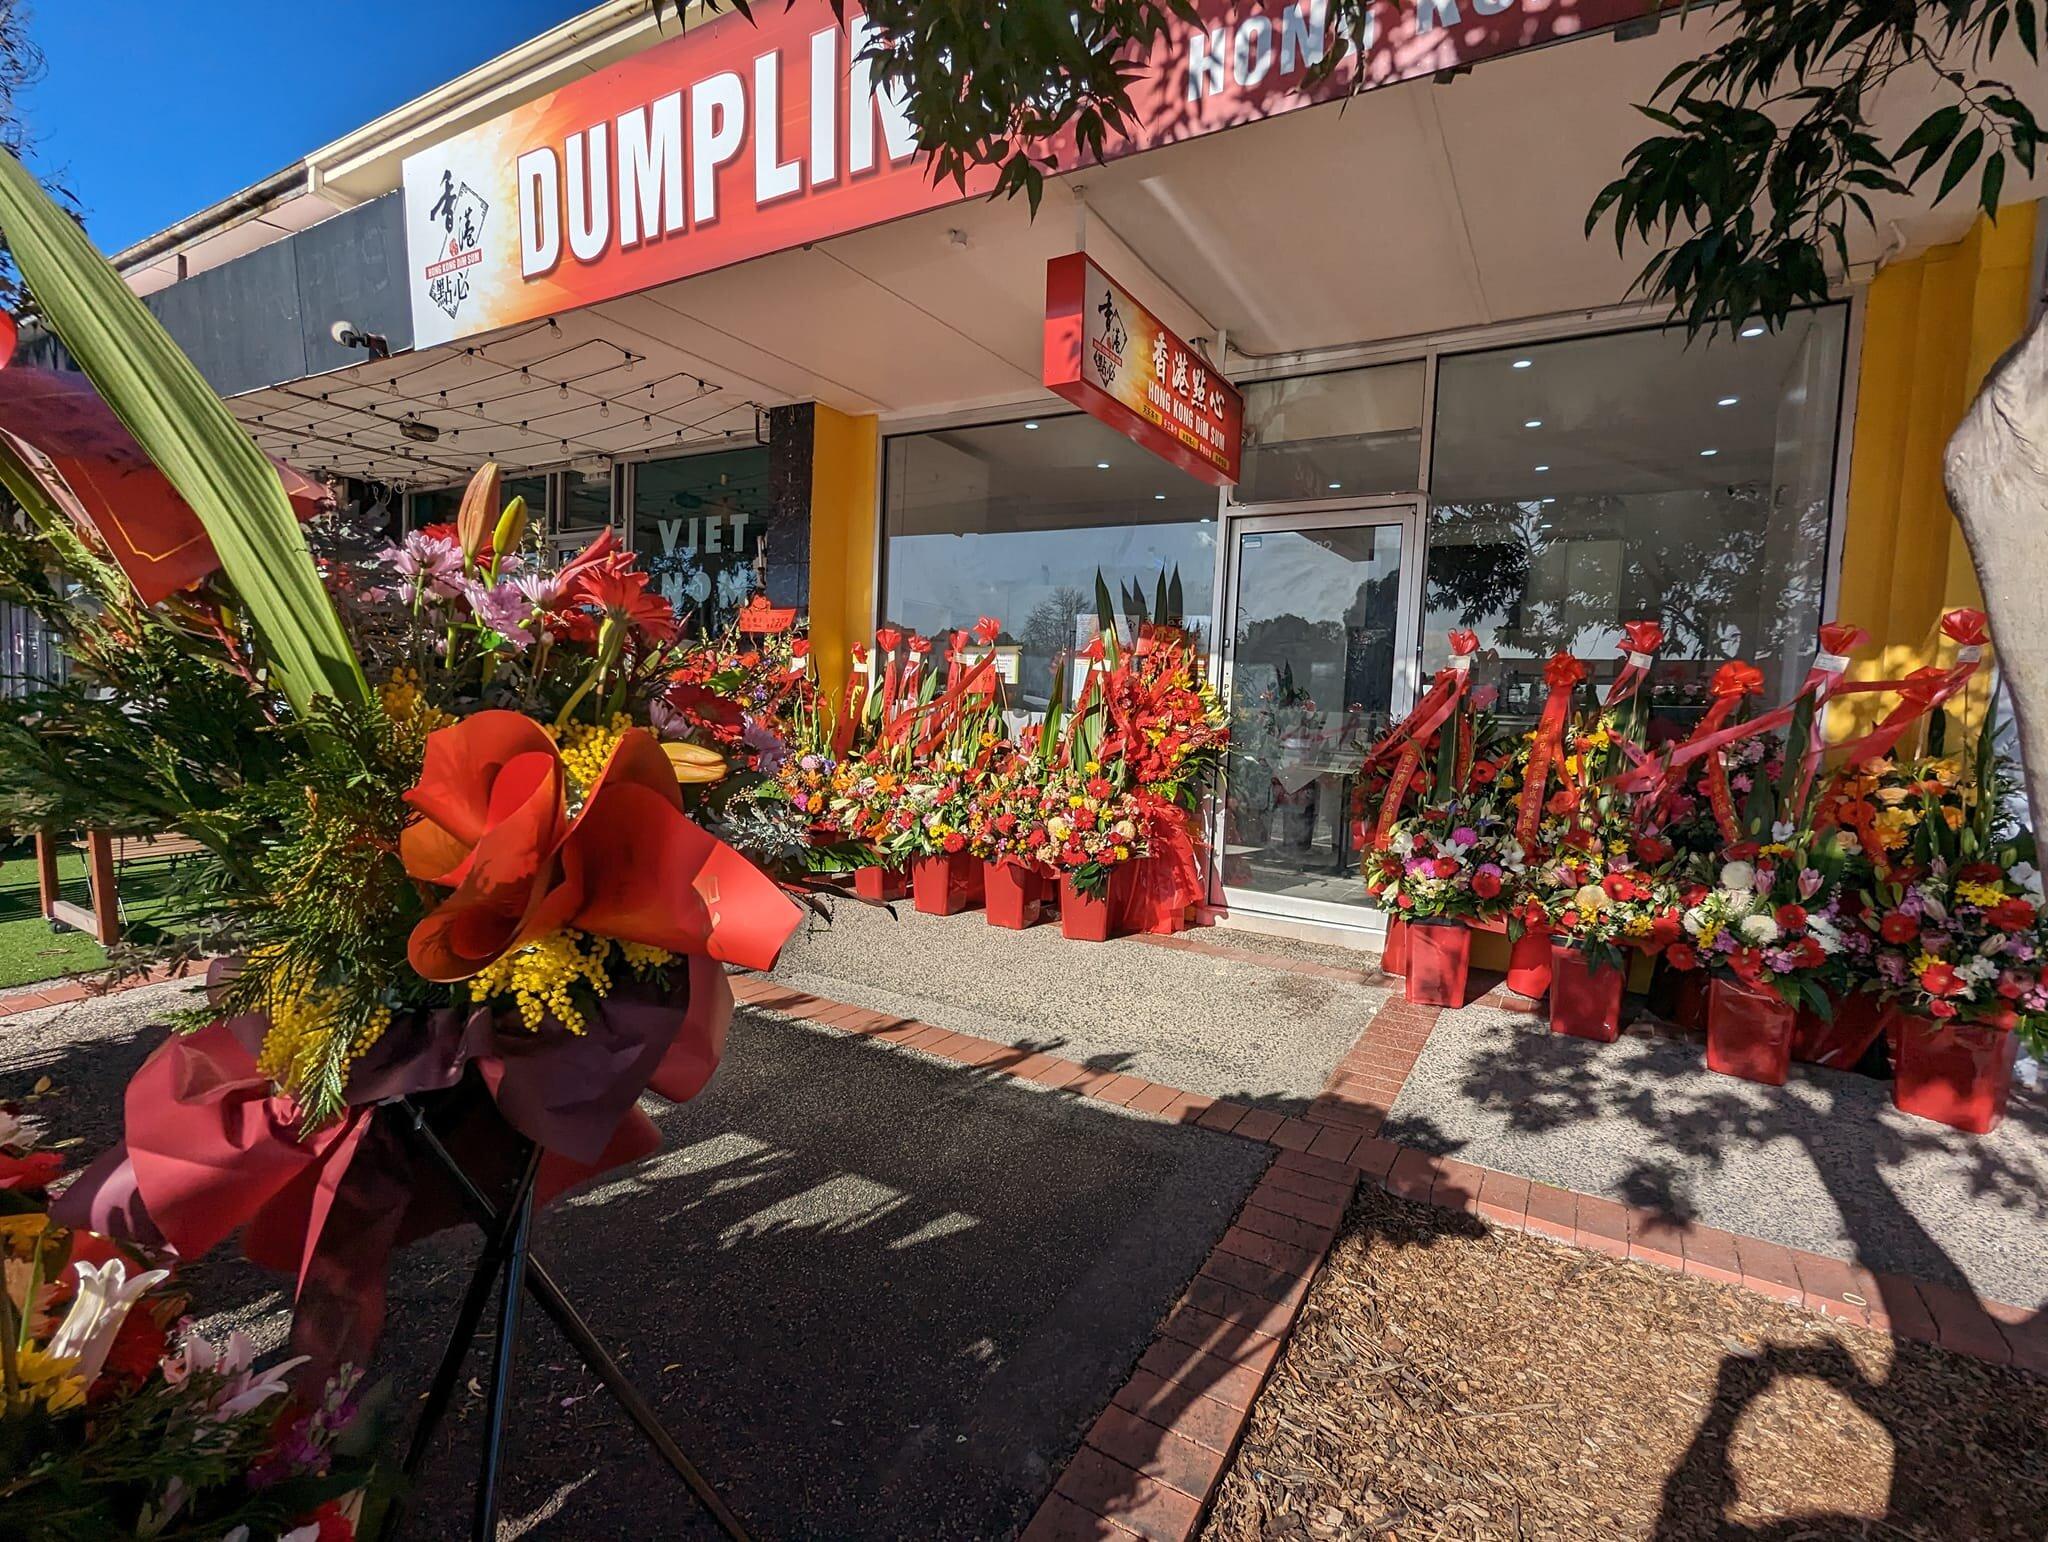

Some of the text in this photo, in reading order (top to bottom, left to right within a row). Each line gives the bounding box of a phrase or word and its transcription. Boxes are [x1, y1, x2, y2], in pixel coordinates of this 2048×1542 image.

[517, 12, 950, 279] DUMPLIN
[1148, 380, 1171, 414] HONG
[1173, 398, 1194, 430] KONG
[1210, 426, 1225, 452] SUM
[657, 513, 750, 557] VIET
